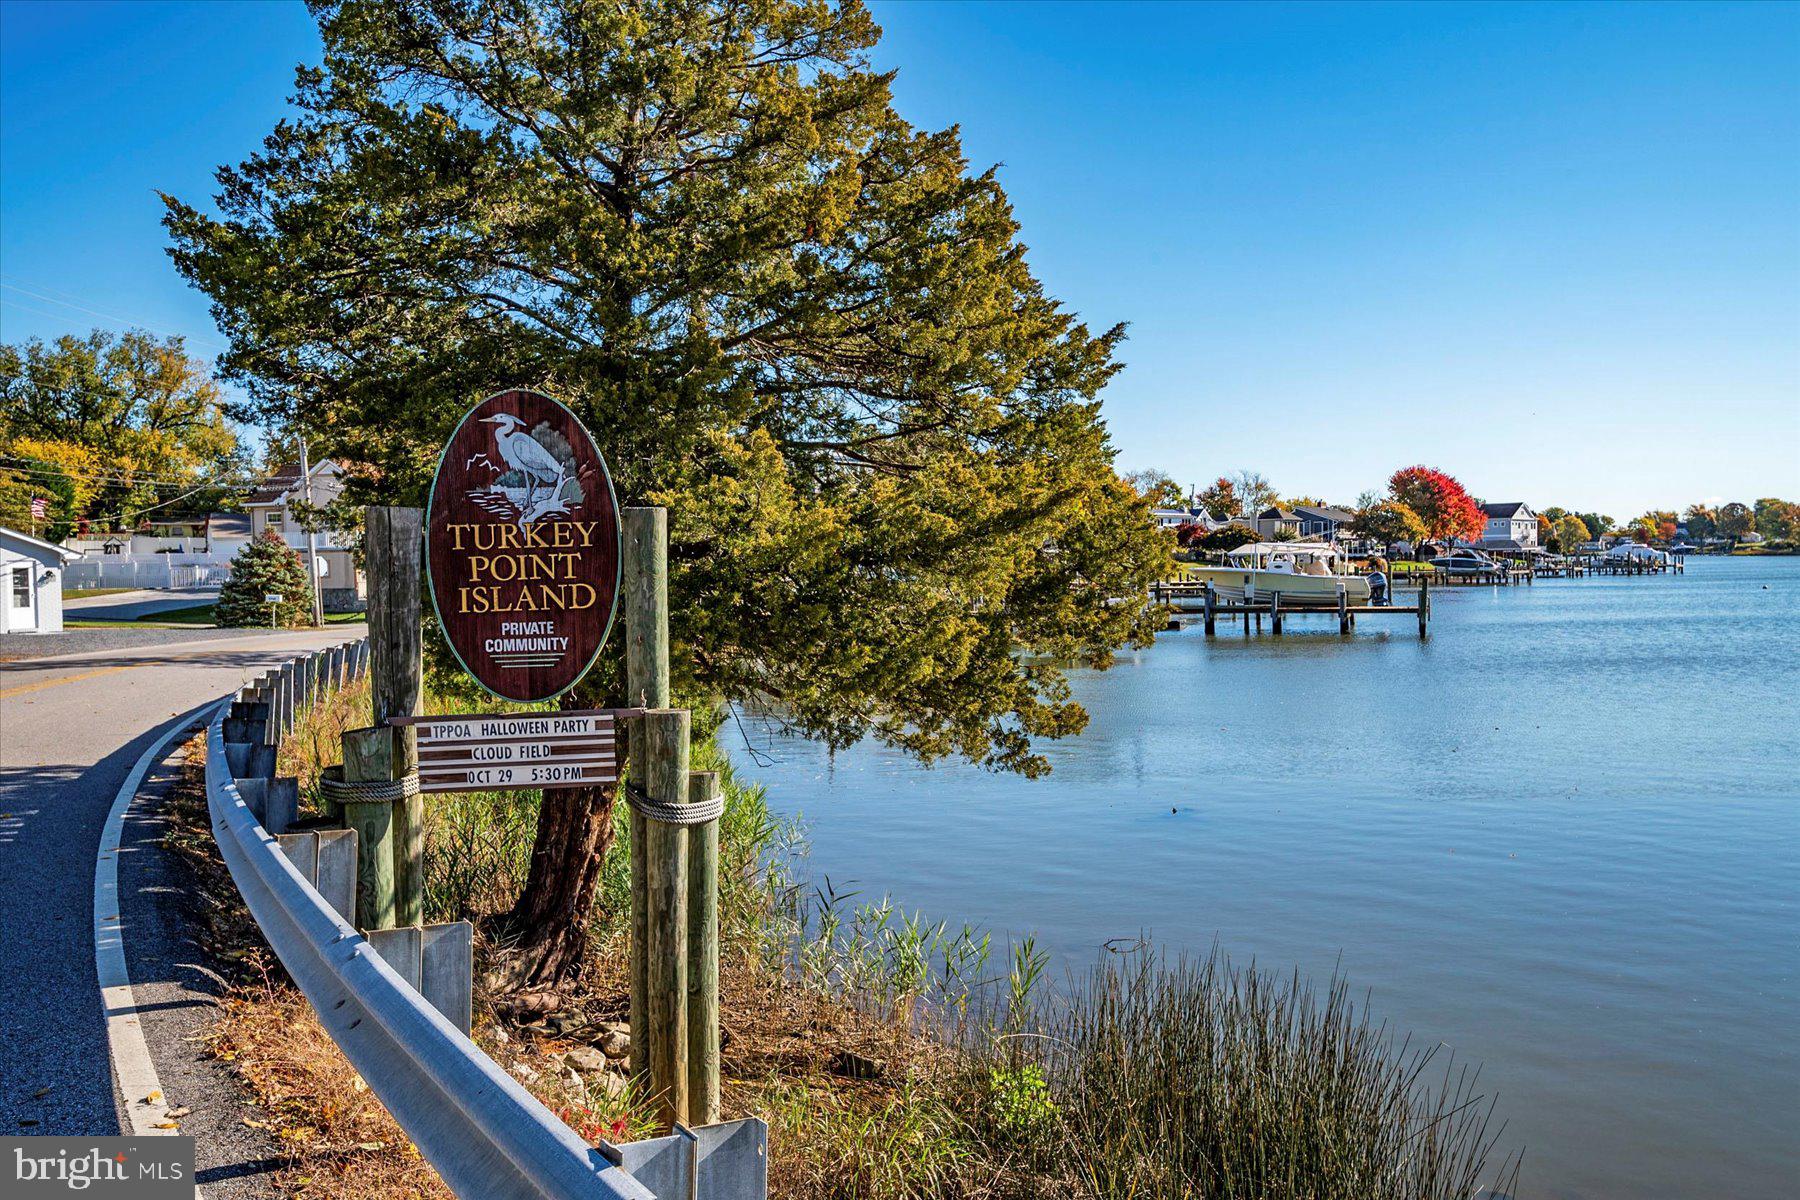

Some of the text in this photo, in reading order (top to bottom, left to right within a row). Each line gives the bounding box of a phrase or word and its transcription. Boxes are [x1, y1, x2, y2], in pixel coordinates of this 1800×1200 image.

[446, 521, 598, 551] TURKEY
[468, 552, 582, 582] POINT
[458, 583, 597, 614] ISLAND
[501, 621, 554, 636] PRIVATE
[485, 637, 569, 652] COMMUNITY
[432, 719, 589, 738] TPPOA HALLOWEEN PARTY
[473, 745, 551, 760] CLOUD FIELD
[498, 769, 513, 782] 29
